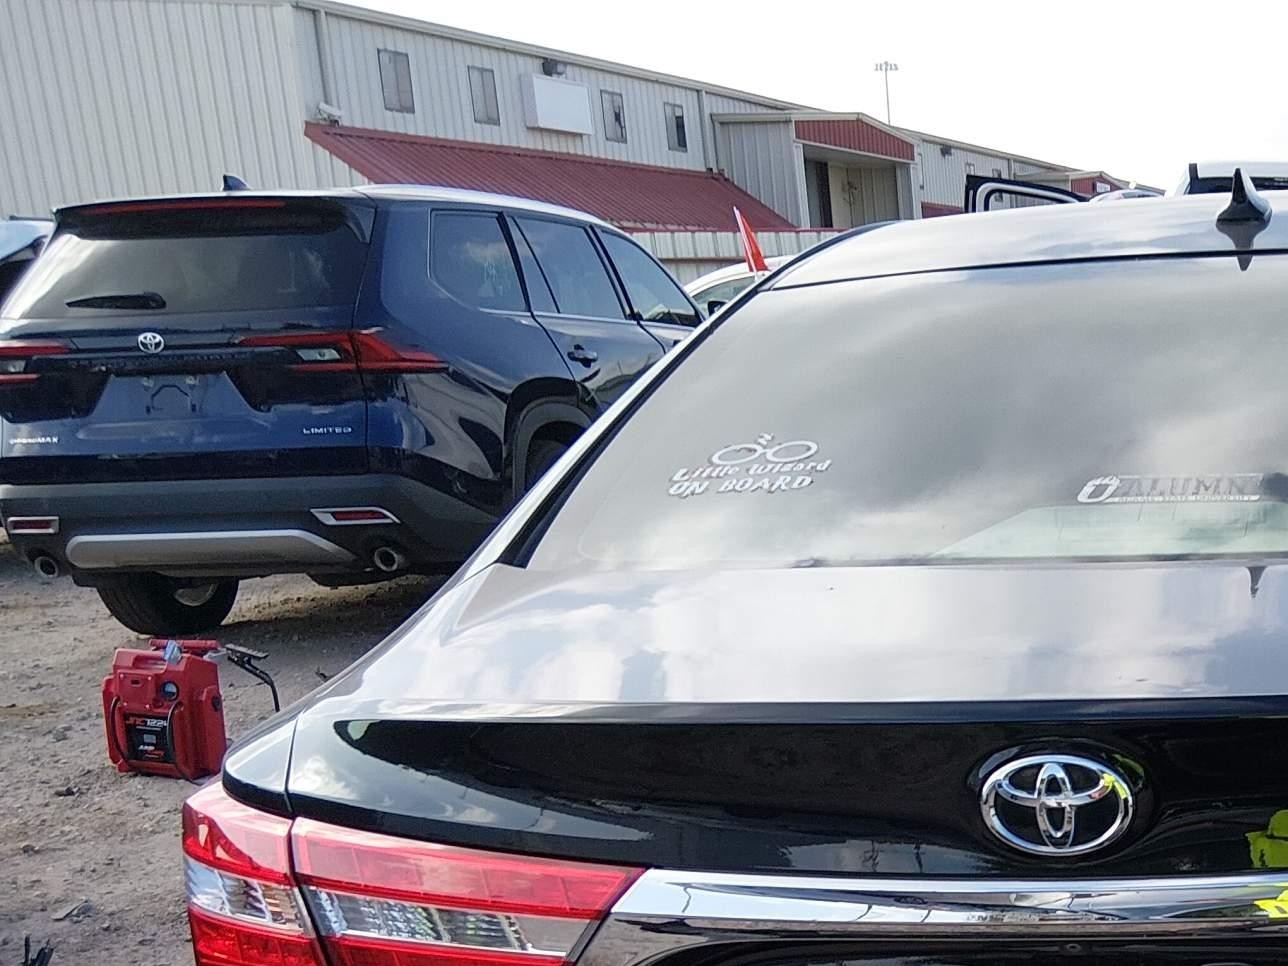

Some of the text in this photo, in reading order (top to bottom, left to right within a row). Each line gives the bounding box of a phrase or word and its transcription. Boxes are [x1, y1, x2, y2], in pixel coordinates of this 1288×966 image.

[302, 426, 353, 434] LIMITED
[668, 475, 812, 497] ON BOARD
[1118, 477, 1259, 496] ALUMN
